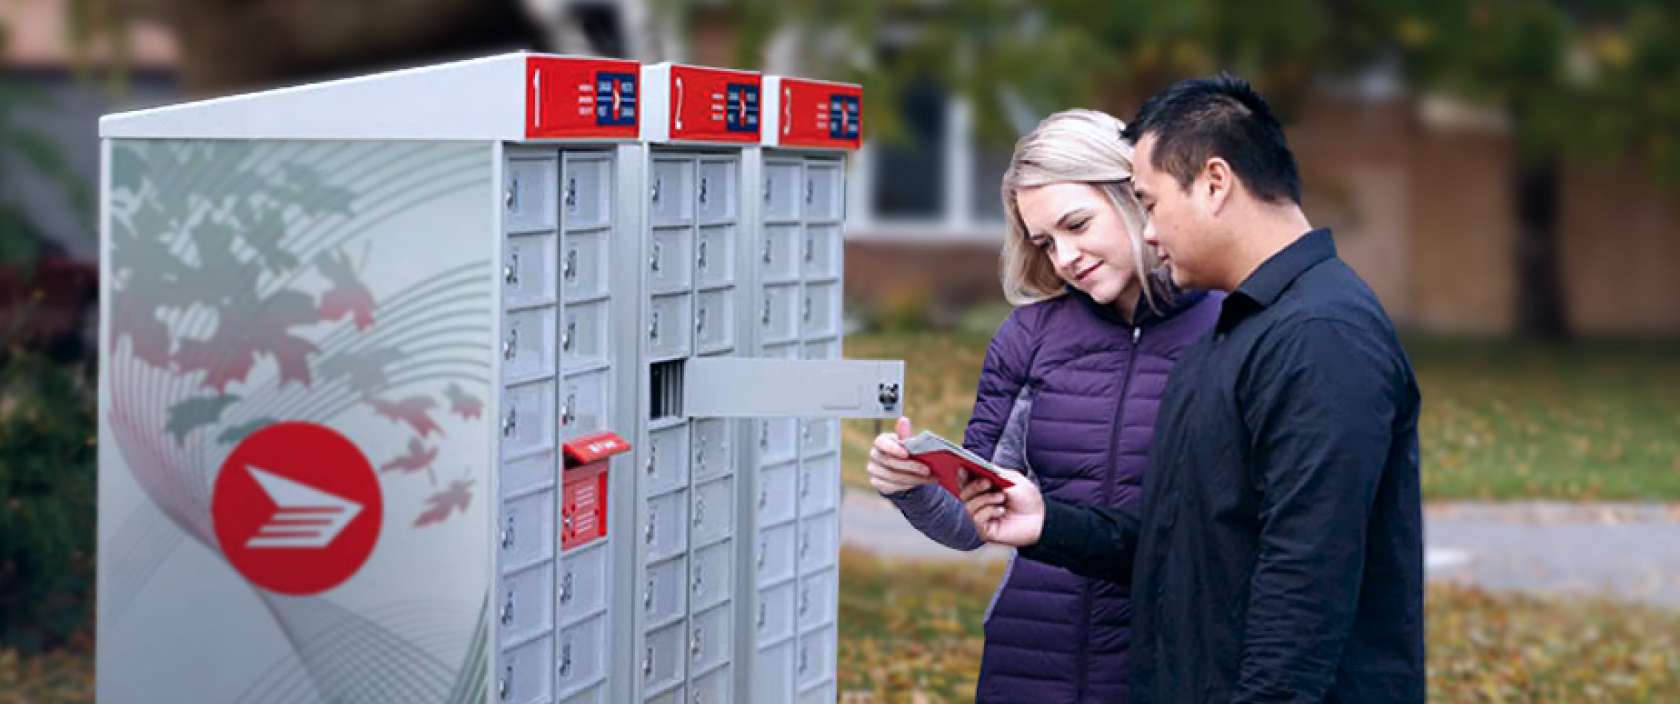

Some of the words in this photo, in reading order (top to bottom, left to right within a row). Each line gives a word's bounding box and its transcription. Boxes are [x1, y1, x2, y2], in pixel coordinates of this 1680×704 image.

[533, 68, 541, 128] 1
[675, 77, 683, 130] 2
[783, 88, 791, 136] 3
